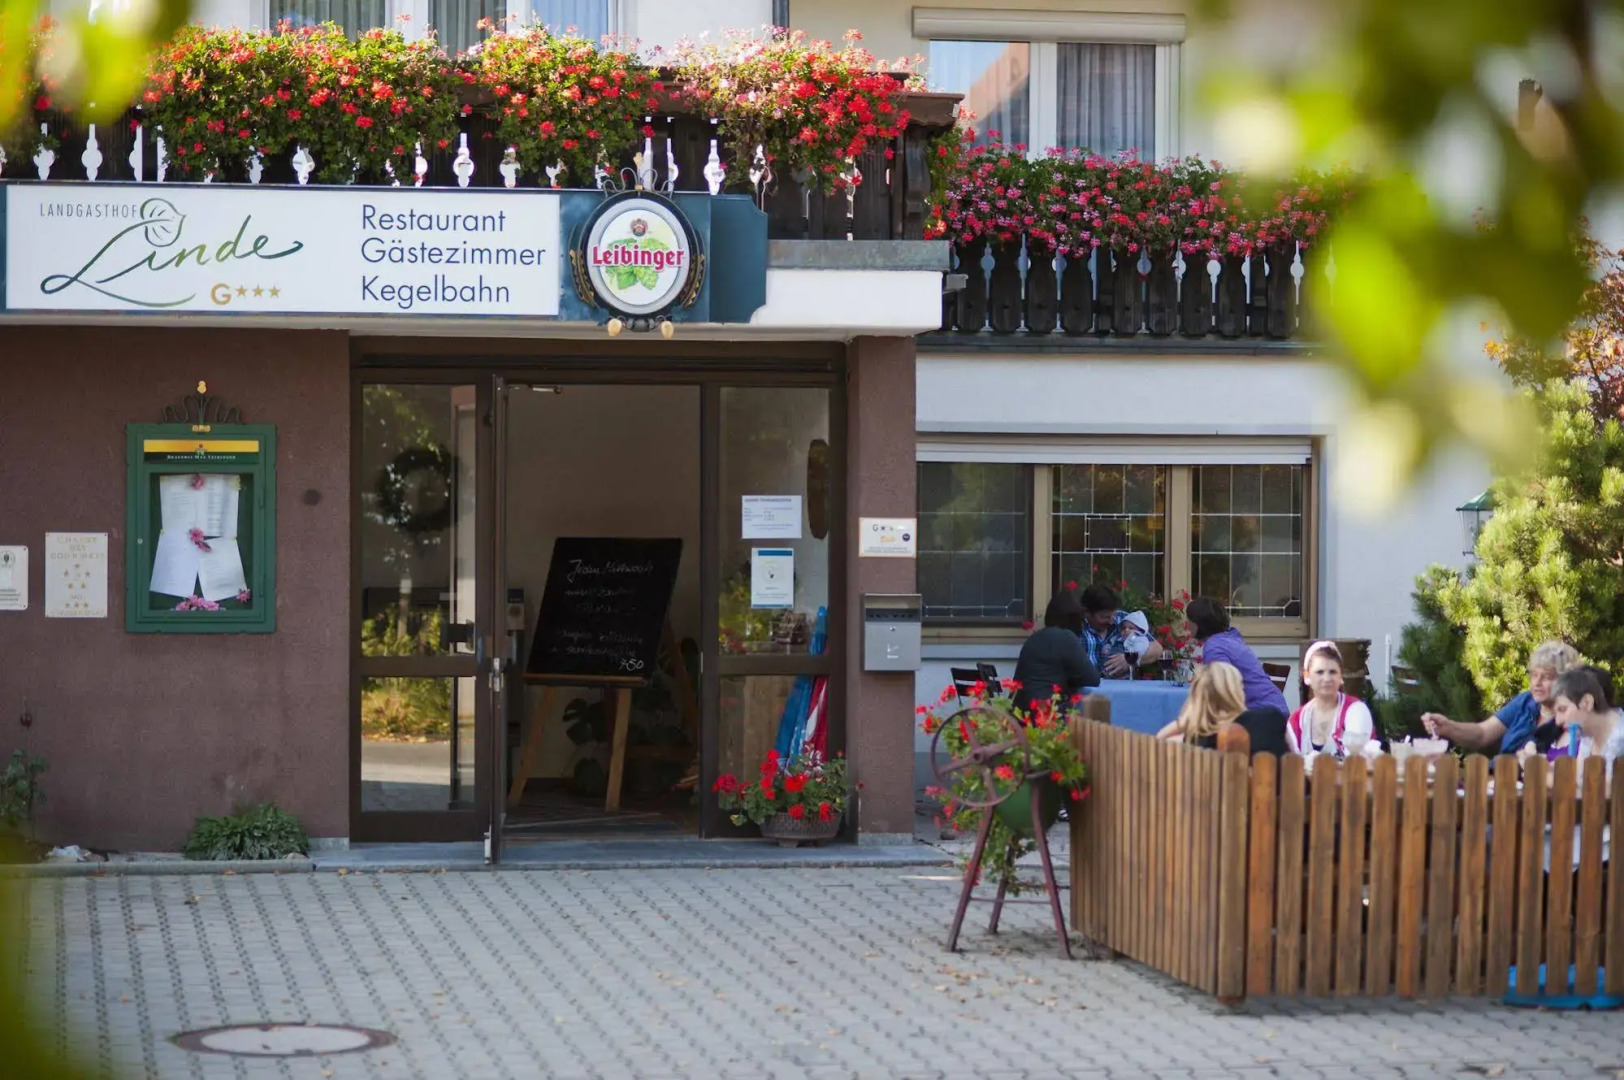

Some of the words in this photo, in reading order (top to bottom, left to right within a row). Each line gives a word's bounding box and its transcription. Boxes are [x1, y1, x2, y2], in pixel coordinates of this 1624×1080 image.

[40, 203, 138, 219] LANDGASTHOF
[362, 204, 506, 232] Restaurant
[40, 214, 304, 307] Linde
[361, 237, 546, 265] Gästezimmer
[591, 244, 685, 271] Leibinger
[362, 274, 510, 309] Kegelbahn
